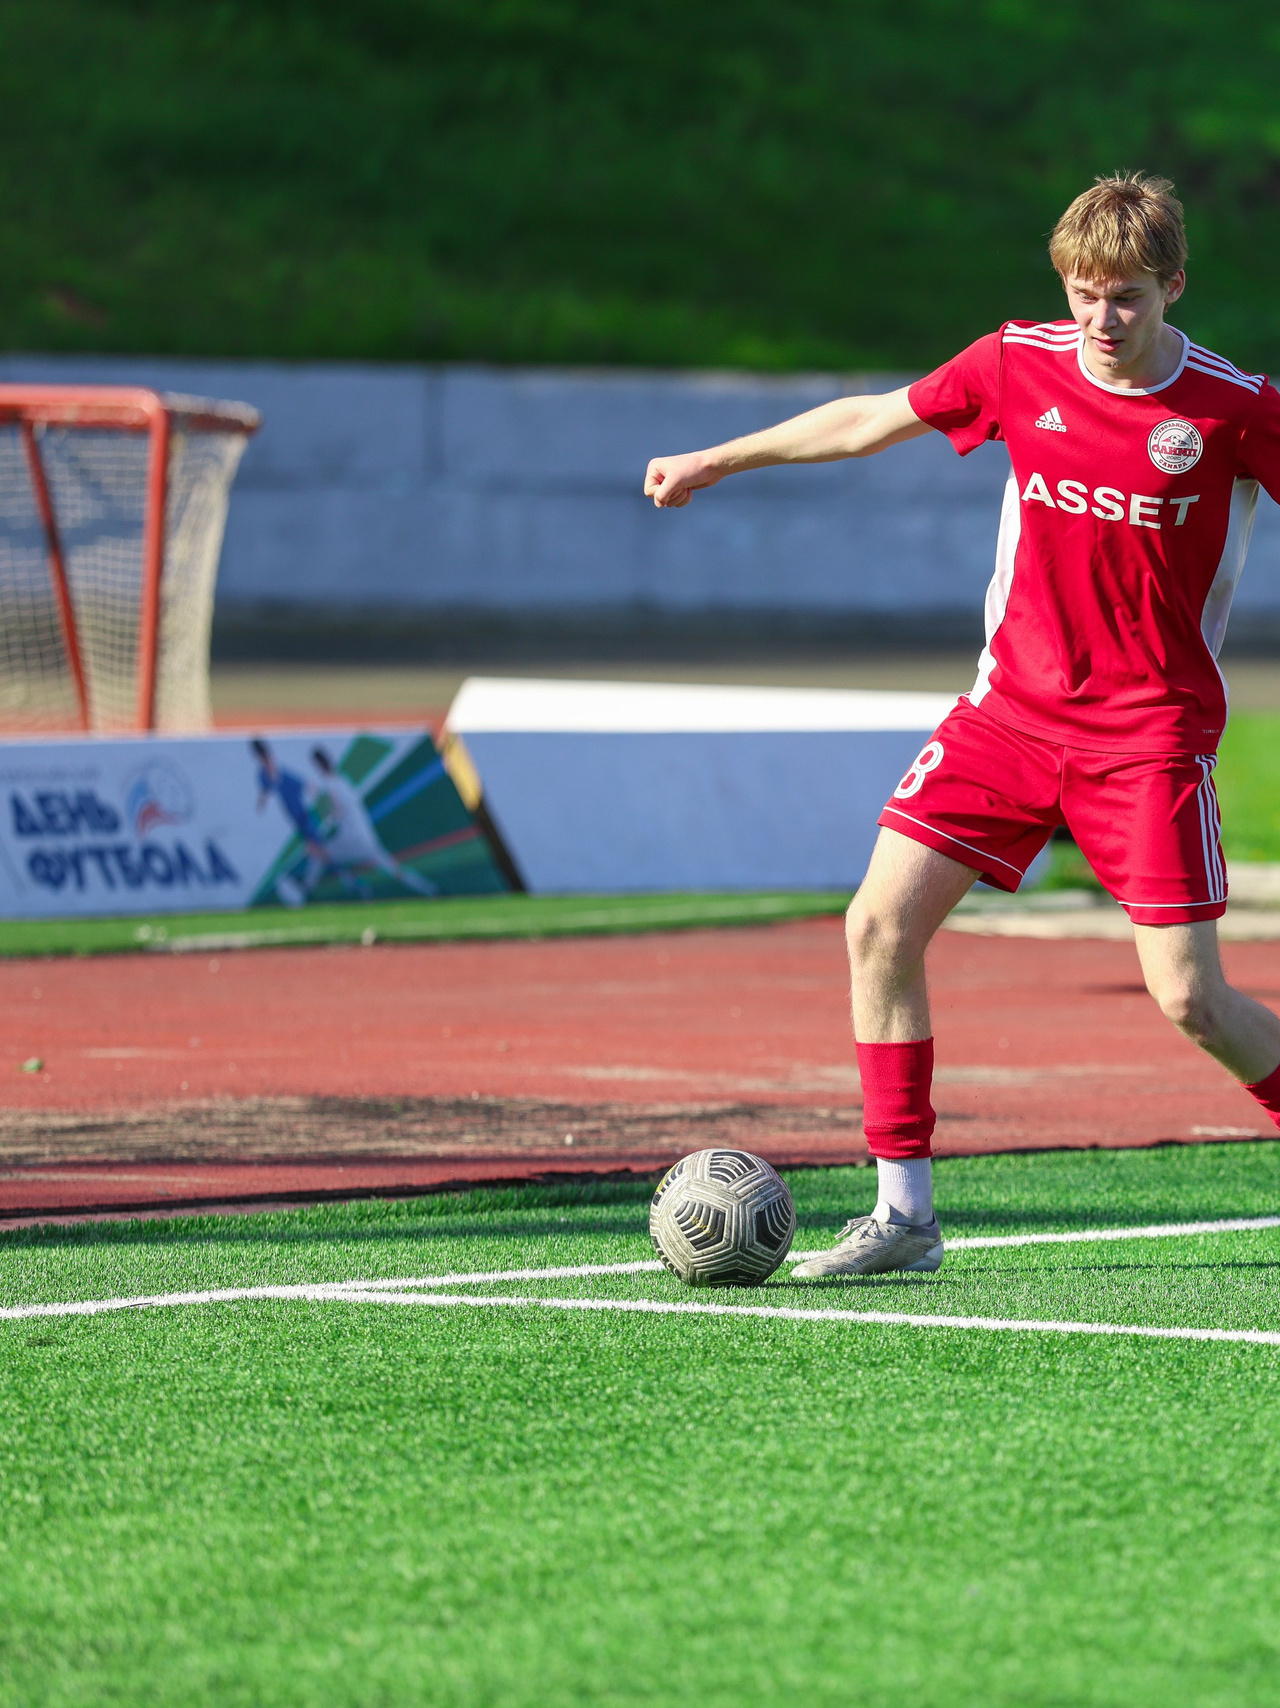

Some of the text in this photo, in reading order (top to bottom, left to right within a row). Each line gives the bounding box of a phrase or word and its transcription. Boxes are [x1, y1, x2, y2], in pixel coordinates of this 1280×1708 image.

[1035, 420, 1067, 433] adidas
[1151, 444, 1198, 457] ОЛИМП
[1158, 458, 1188, 469] САМАРА
[1021, 471, 1200, 529] ASSET
[893, 740, 945, 799] 8
[9, 789, 121, 838] ДЕНЬ
[26, 836, 242, 892] ФУТБОЛА
